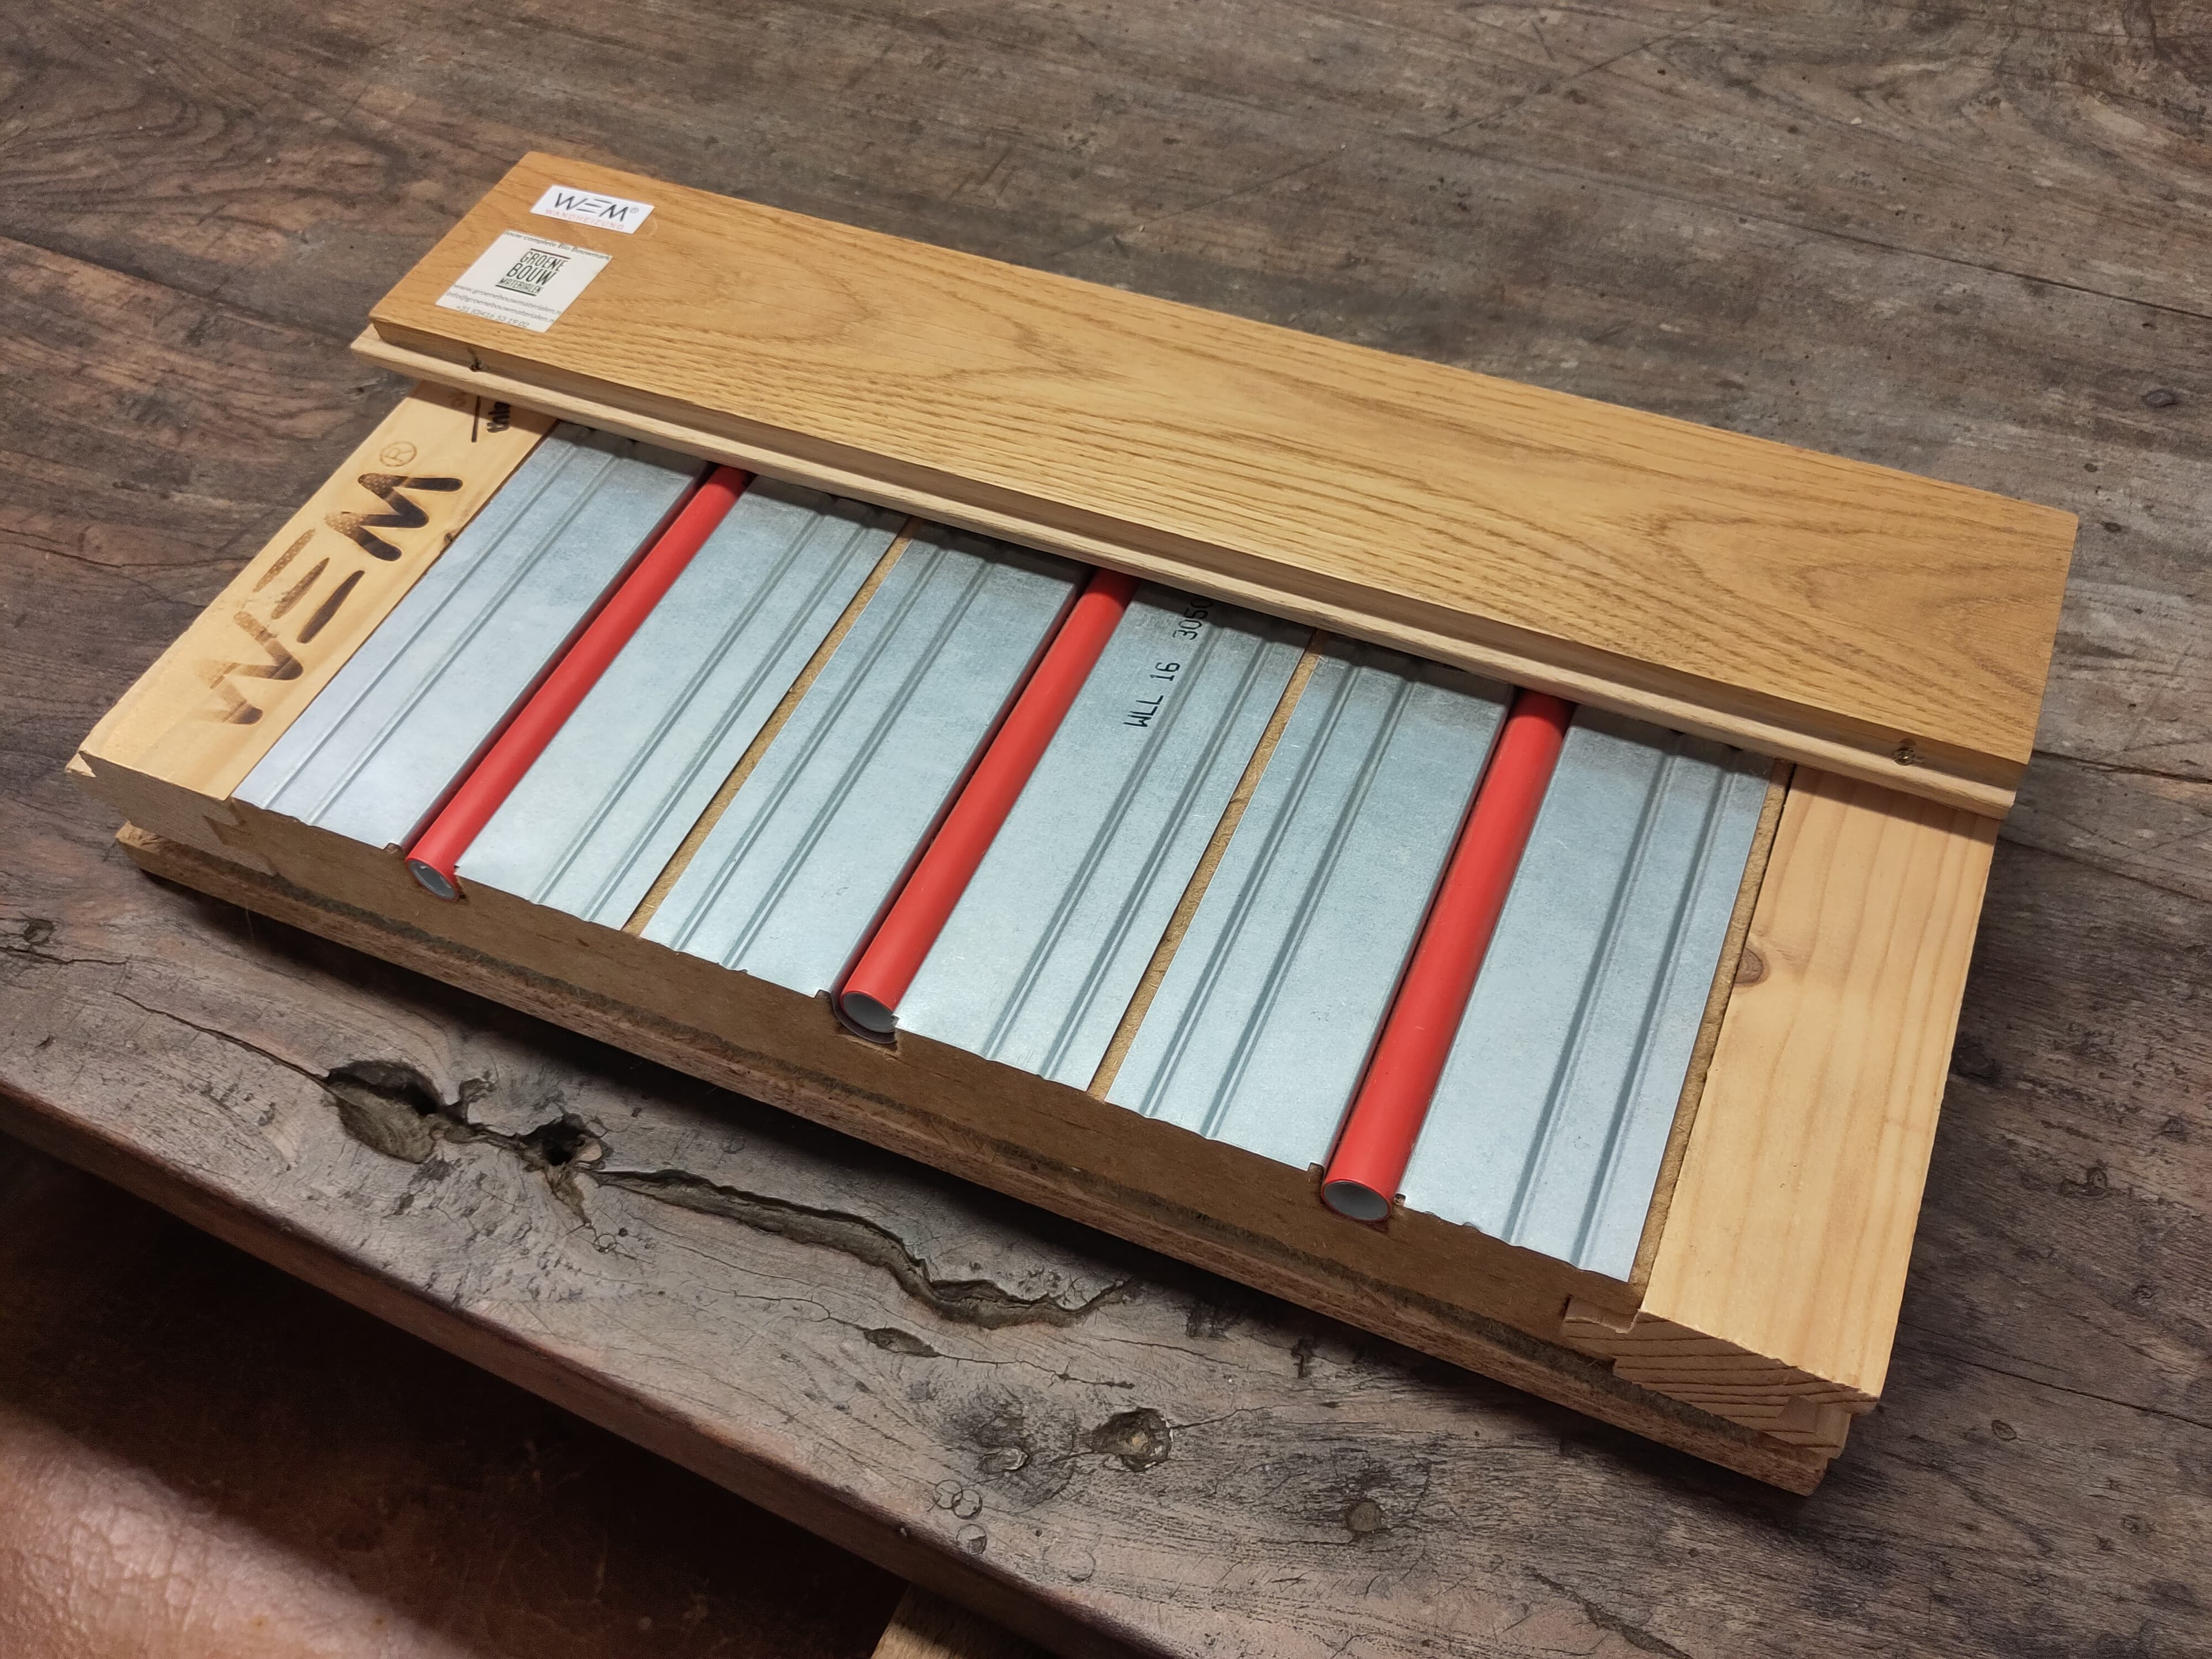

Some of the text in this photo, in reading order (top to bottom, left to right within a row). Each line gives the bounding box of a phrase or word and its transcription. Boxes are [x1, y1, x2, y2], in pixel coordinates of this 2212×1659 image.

[544, 209, 625, 230] WANDHEIZUNG
[523, 236, 557, 247] complete
[558, 243, 570, 251] Bio
[571, 246, 611, 260] Bouwmark
[520, 251, 569, 272] GROENE
[498, 277, 545, 294] MATERIALEN
[506, 263, 558, 286] BOUW
[446, 291, 555, 323] info@groenebouwmaterialen.n
[453, 284, 562, 316] www.groenebouwmaterialen.n
[1123, 598, 1214, 727] WLL 16 3050
